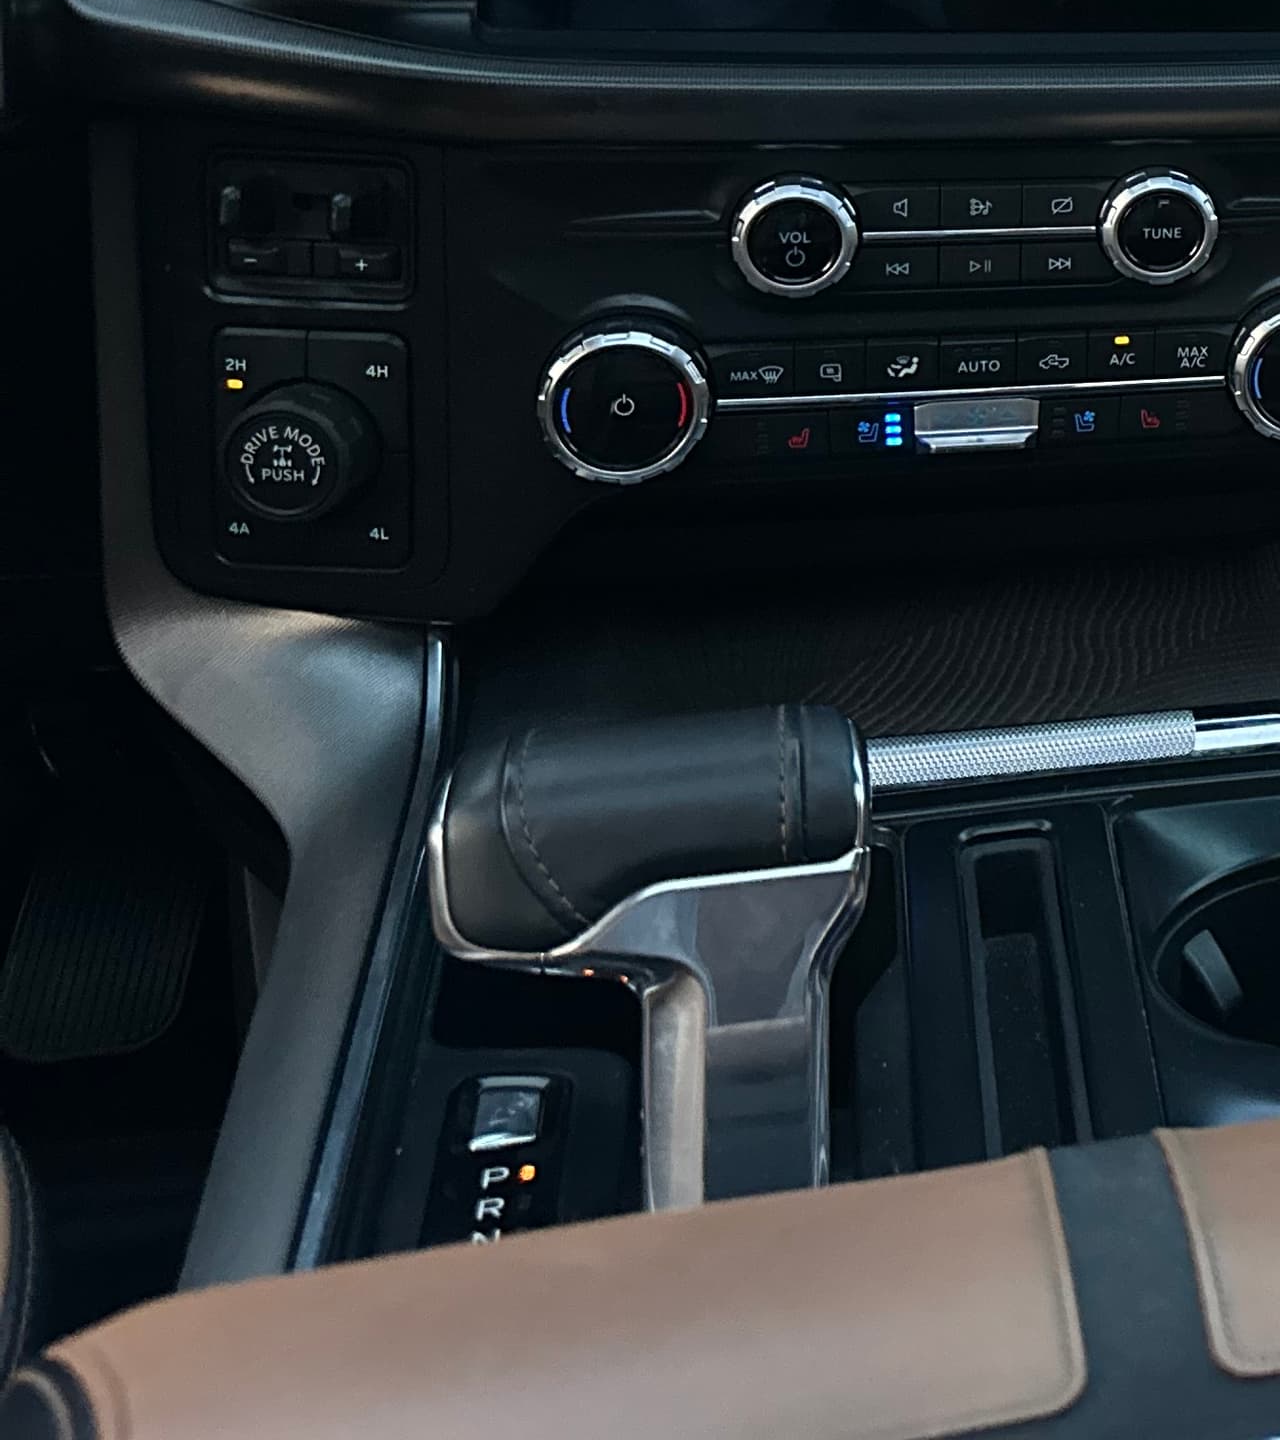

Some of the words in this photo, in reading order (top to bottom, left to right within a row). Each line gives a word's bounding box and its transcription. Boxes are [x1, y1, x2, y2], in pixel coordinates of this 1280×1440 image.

[778, 231, 812, 245] VOL
[1142, 226, 1182, 240] TUNE
[1177, 345, 1209, 358] MAX
[225, 358, 247, 372] 2H
[1109, 352, 1136, 366] A/C
[1179, 356, 1206, 369] A/C
[365, 364, 389, 378] 4H
[957, 359, 1001, 374] AUTO
[730, 369, 759, 382] MAX
[239, 425, 280, 466] DRIVE
[283, 425, 326, 468] MODE
[260, 467, 305, 483] PUSH
[228, 522, 250, 536] 4A
[369, 527, 390, 541] 4L
[480, 1165, 510, 1190] P
[475, 1196, 505, 1222] R
